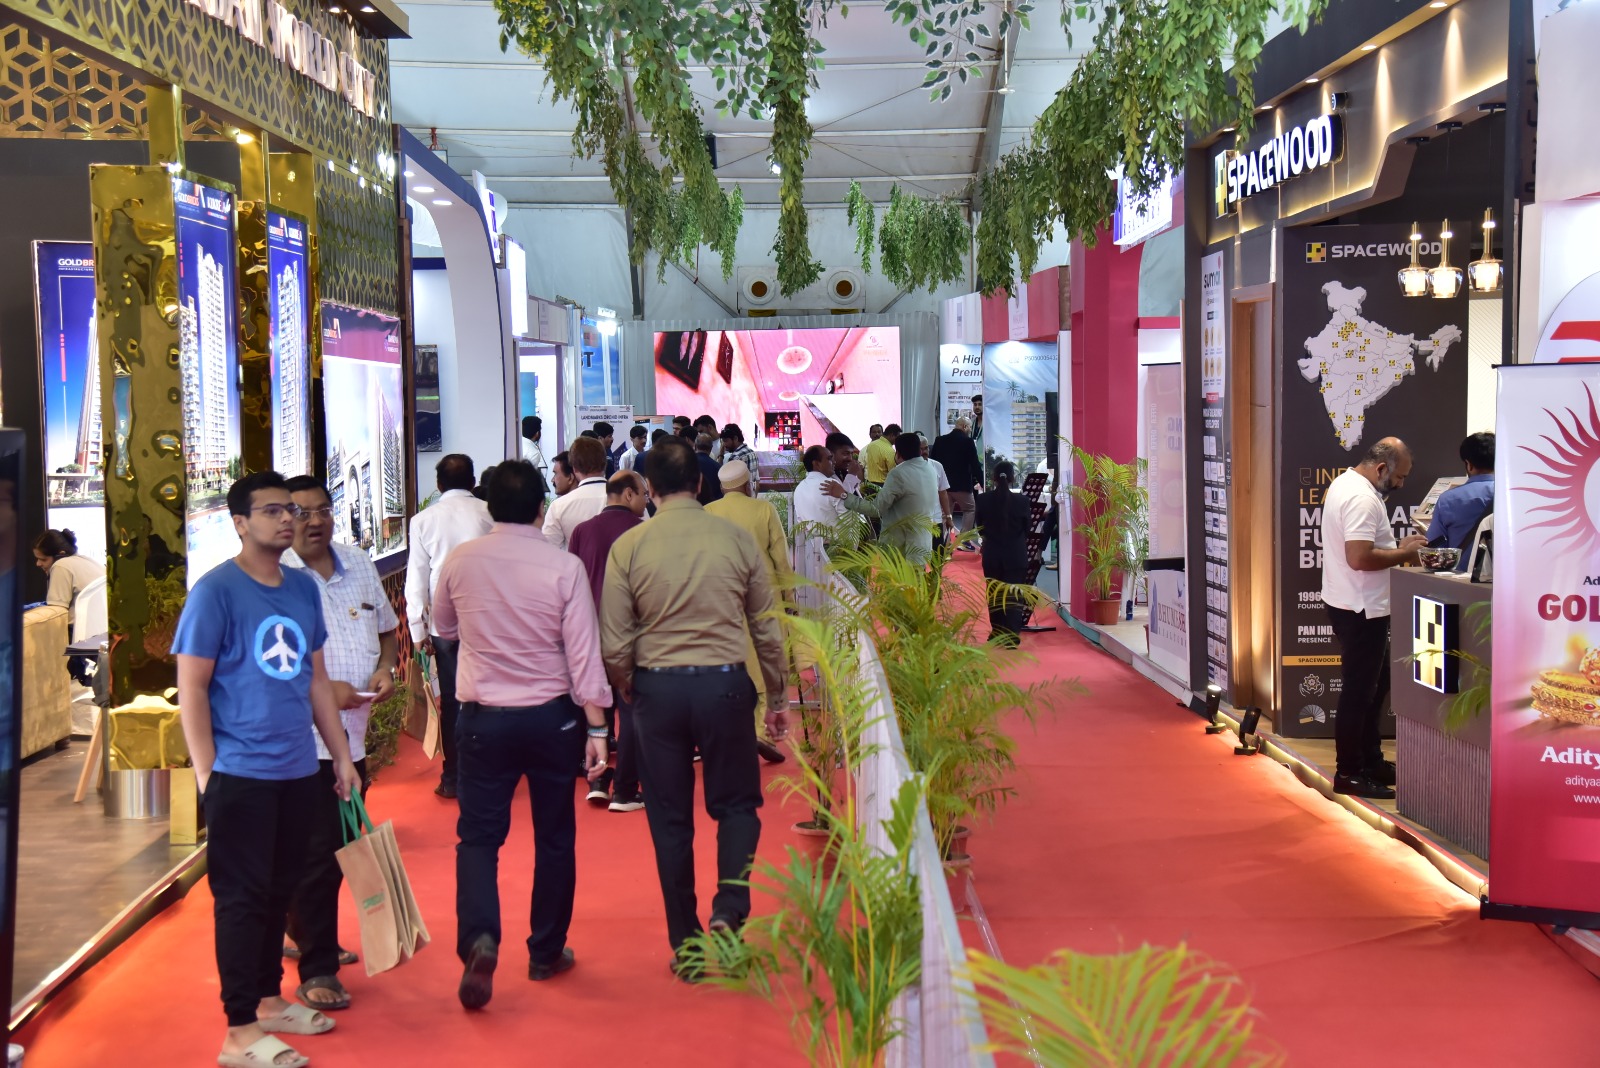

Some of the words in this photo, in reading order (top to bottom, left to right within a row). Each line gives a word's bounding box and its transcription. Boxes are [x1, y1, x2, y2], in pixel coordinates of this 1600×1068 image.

[340, 52, 375, 119] CITY
[1228, 115, 1332, 203] SPACEWOOD
[1331, 241, 1443, 258] SPACEWOOD
[952, 355, 959, 364] A
[1298, 592, 1321, 601] 1996
[1538, 593, 1600, 622] GOL
[1298, 626, 1315, 635] PAN
